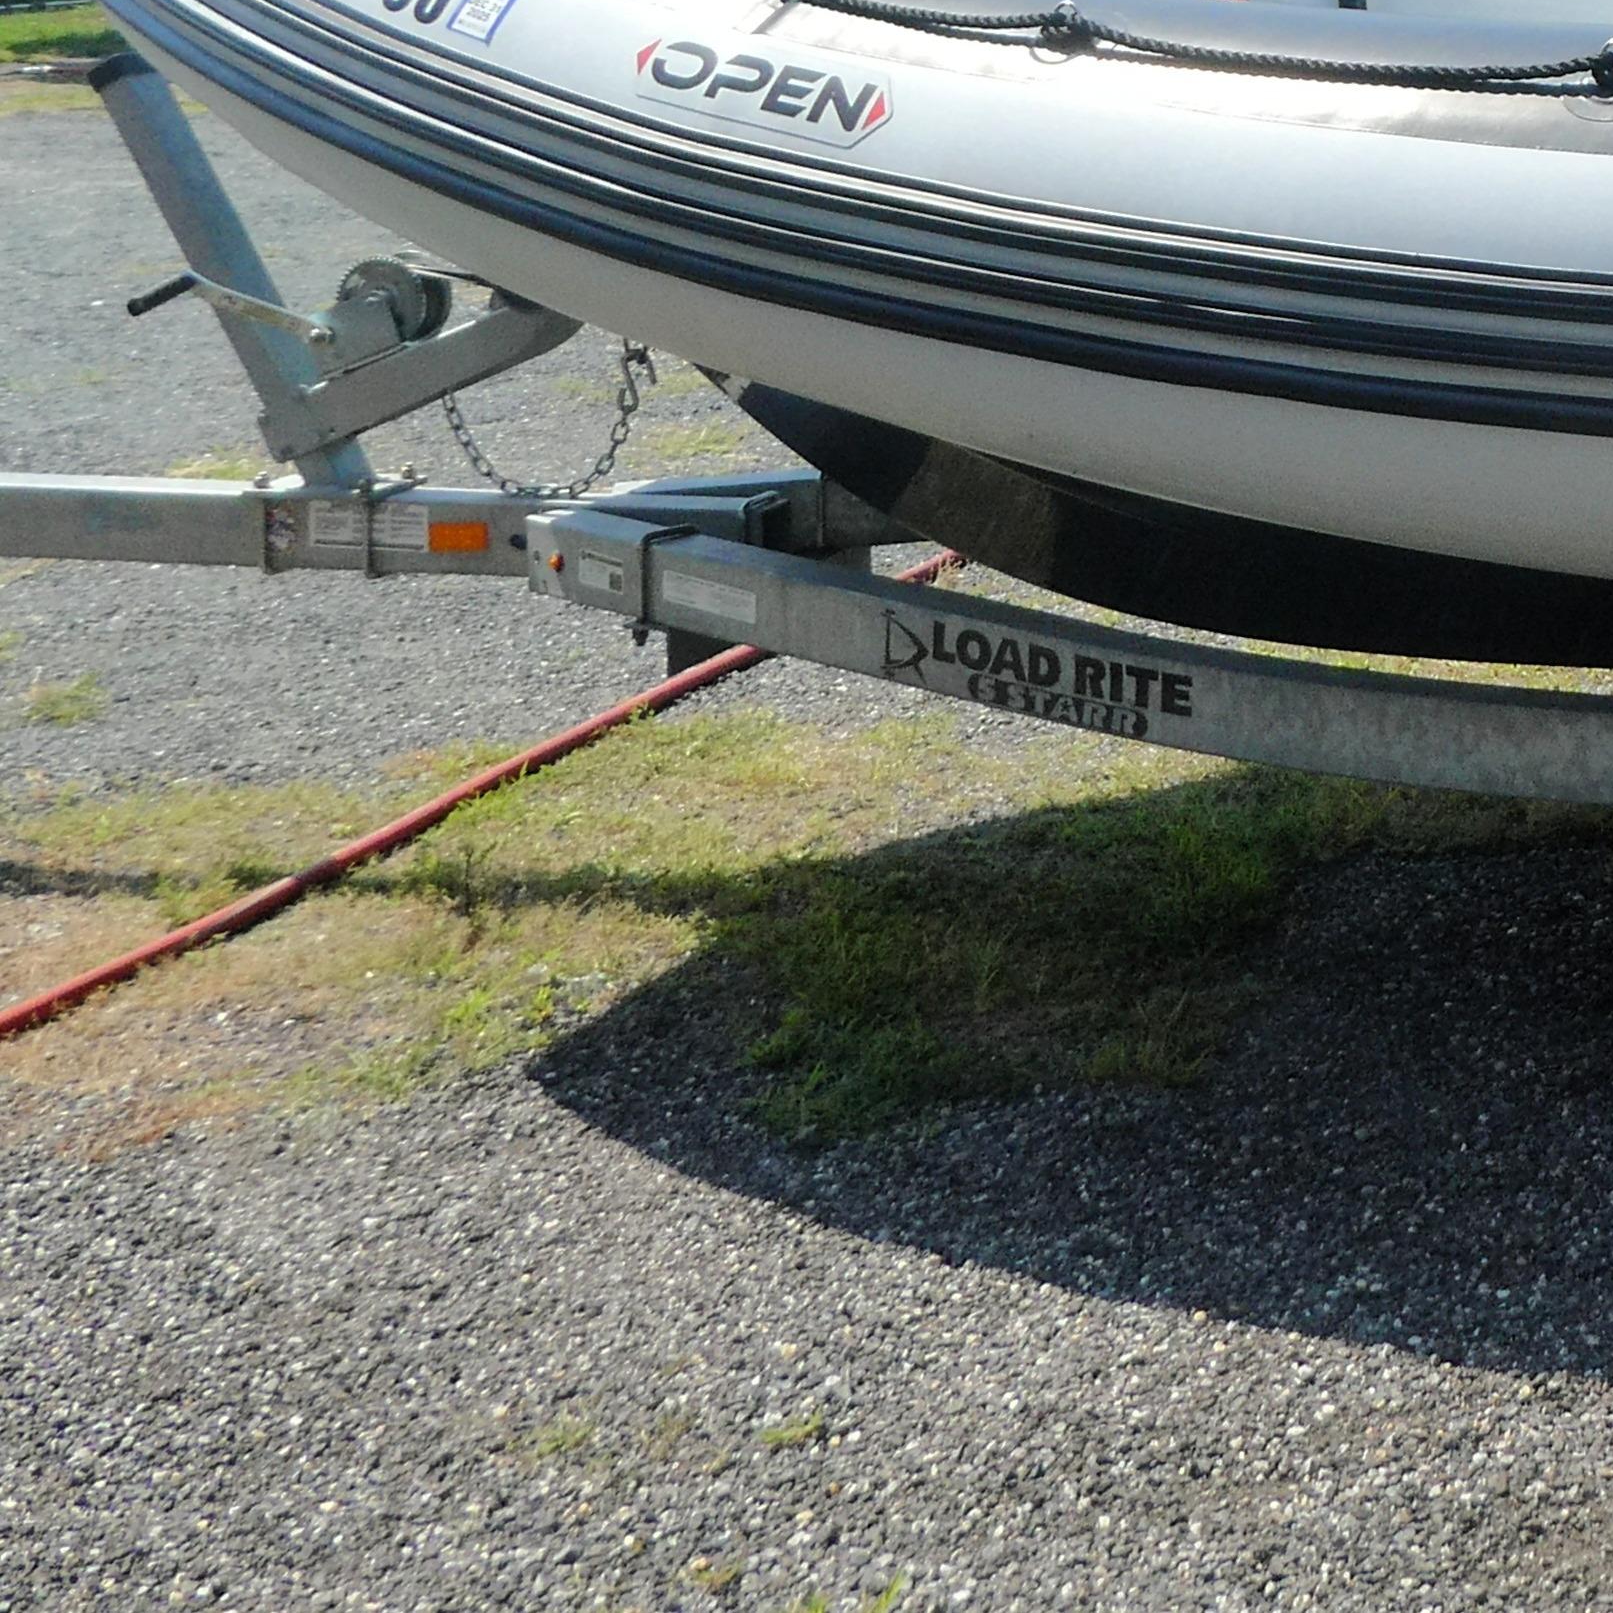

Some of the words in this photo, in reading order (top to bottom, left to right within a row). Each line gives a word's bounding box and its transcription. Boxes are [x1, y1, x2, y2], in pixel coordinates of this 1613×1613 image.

[651, 41, 878, 132] OPEN
[932, 620, 1063, 688] LOAD
[1073, 653, 1194, 718] RITE
